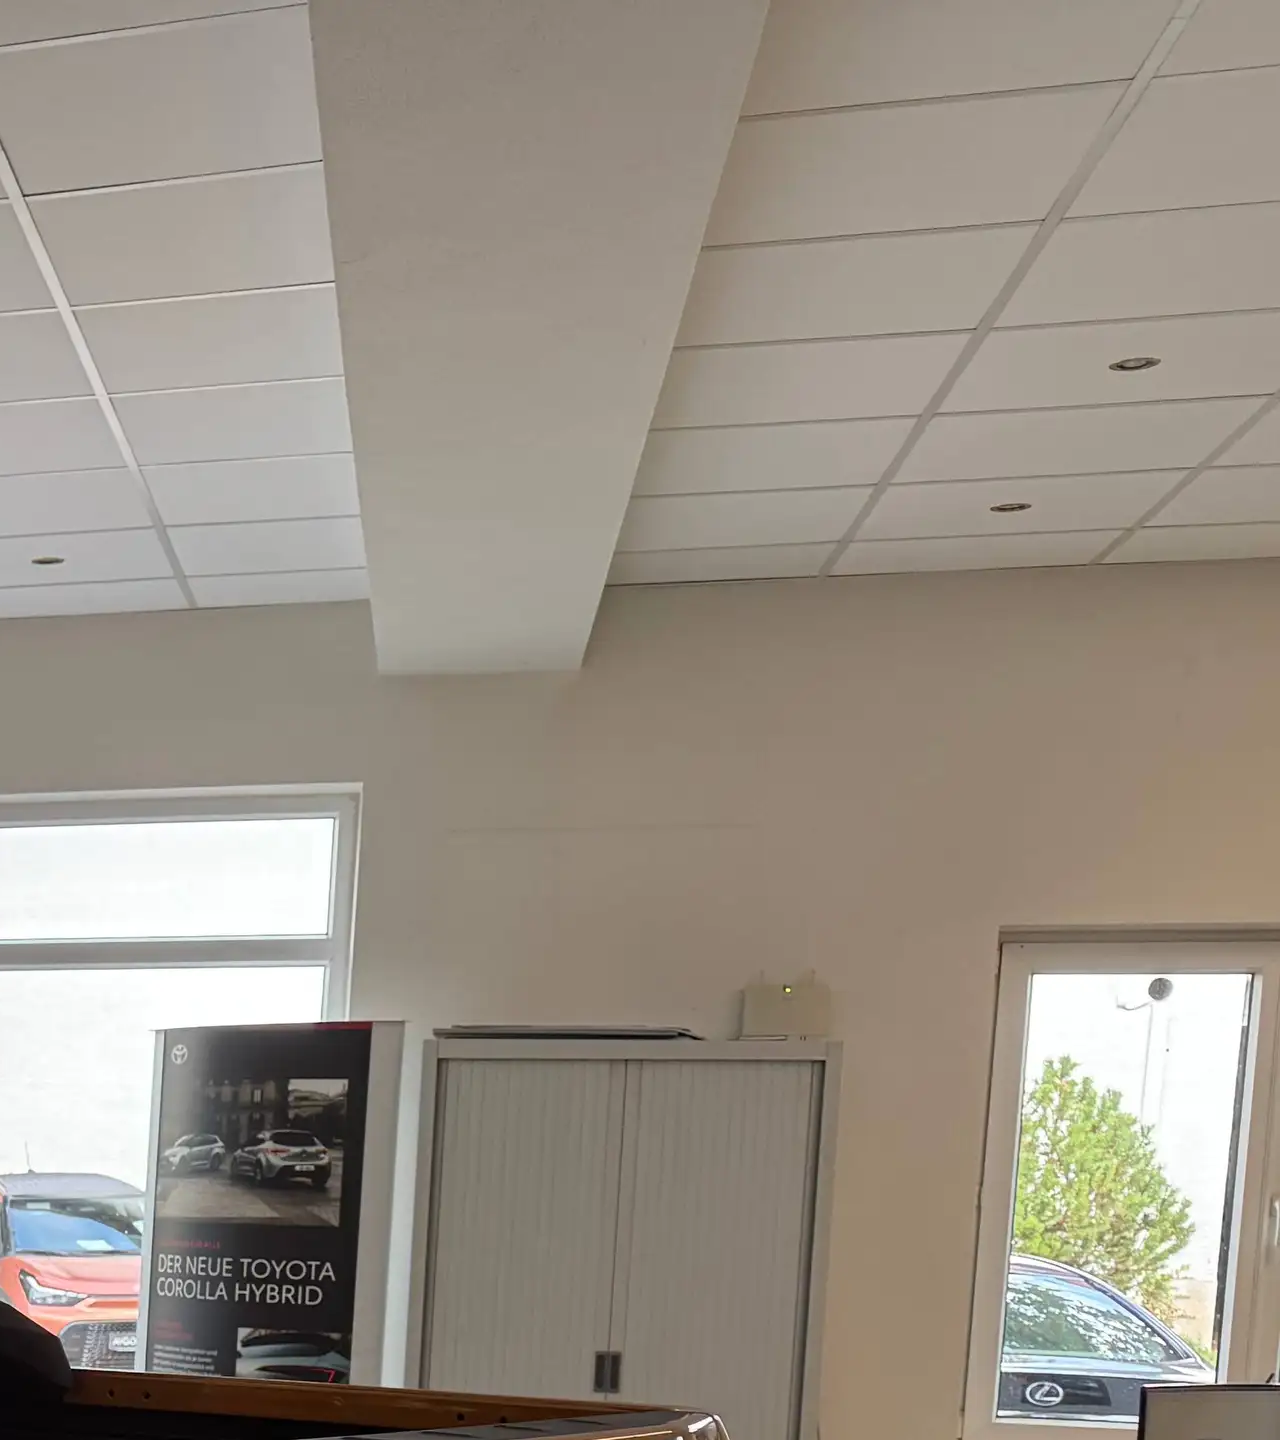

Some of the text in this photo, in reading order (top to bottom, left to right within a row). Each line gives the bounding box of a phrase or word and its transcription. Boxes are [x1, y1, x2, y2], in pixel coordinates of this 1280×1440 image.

[158, 1253, 336, 1282] DER NEUE TOYOTA
[157, 1277, 323, 1306] COROLLA HYBRID
